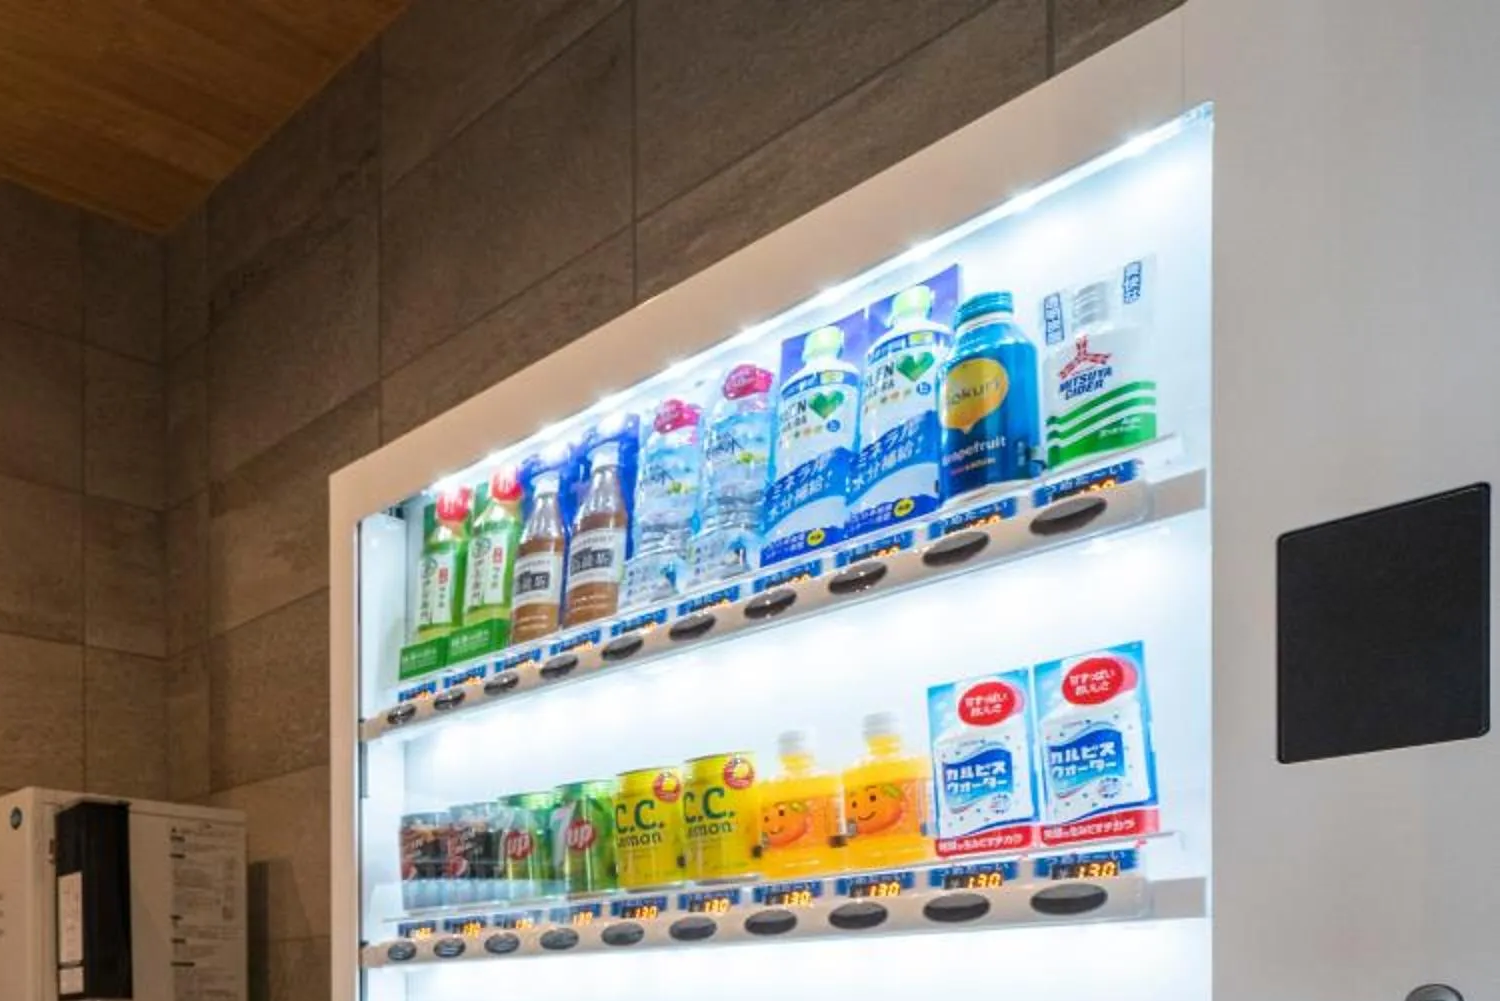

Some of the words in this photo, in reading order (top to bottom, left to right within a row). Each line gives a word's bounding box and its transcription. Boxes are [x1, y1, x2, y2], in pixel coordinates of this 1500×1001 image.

[1059, 367, 1113, 393] MITSUYA
[1064, 380, 1104, 401] CIDER
[1051, 742, 1117, 765] カルピス
[946, 762, 1008, 781] カルピス
[1078, 860, 1117, 878] 130
[868, 881, 901, 897] 130
[967, 872, 1002, 889] 130
